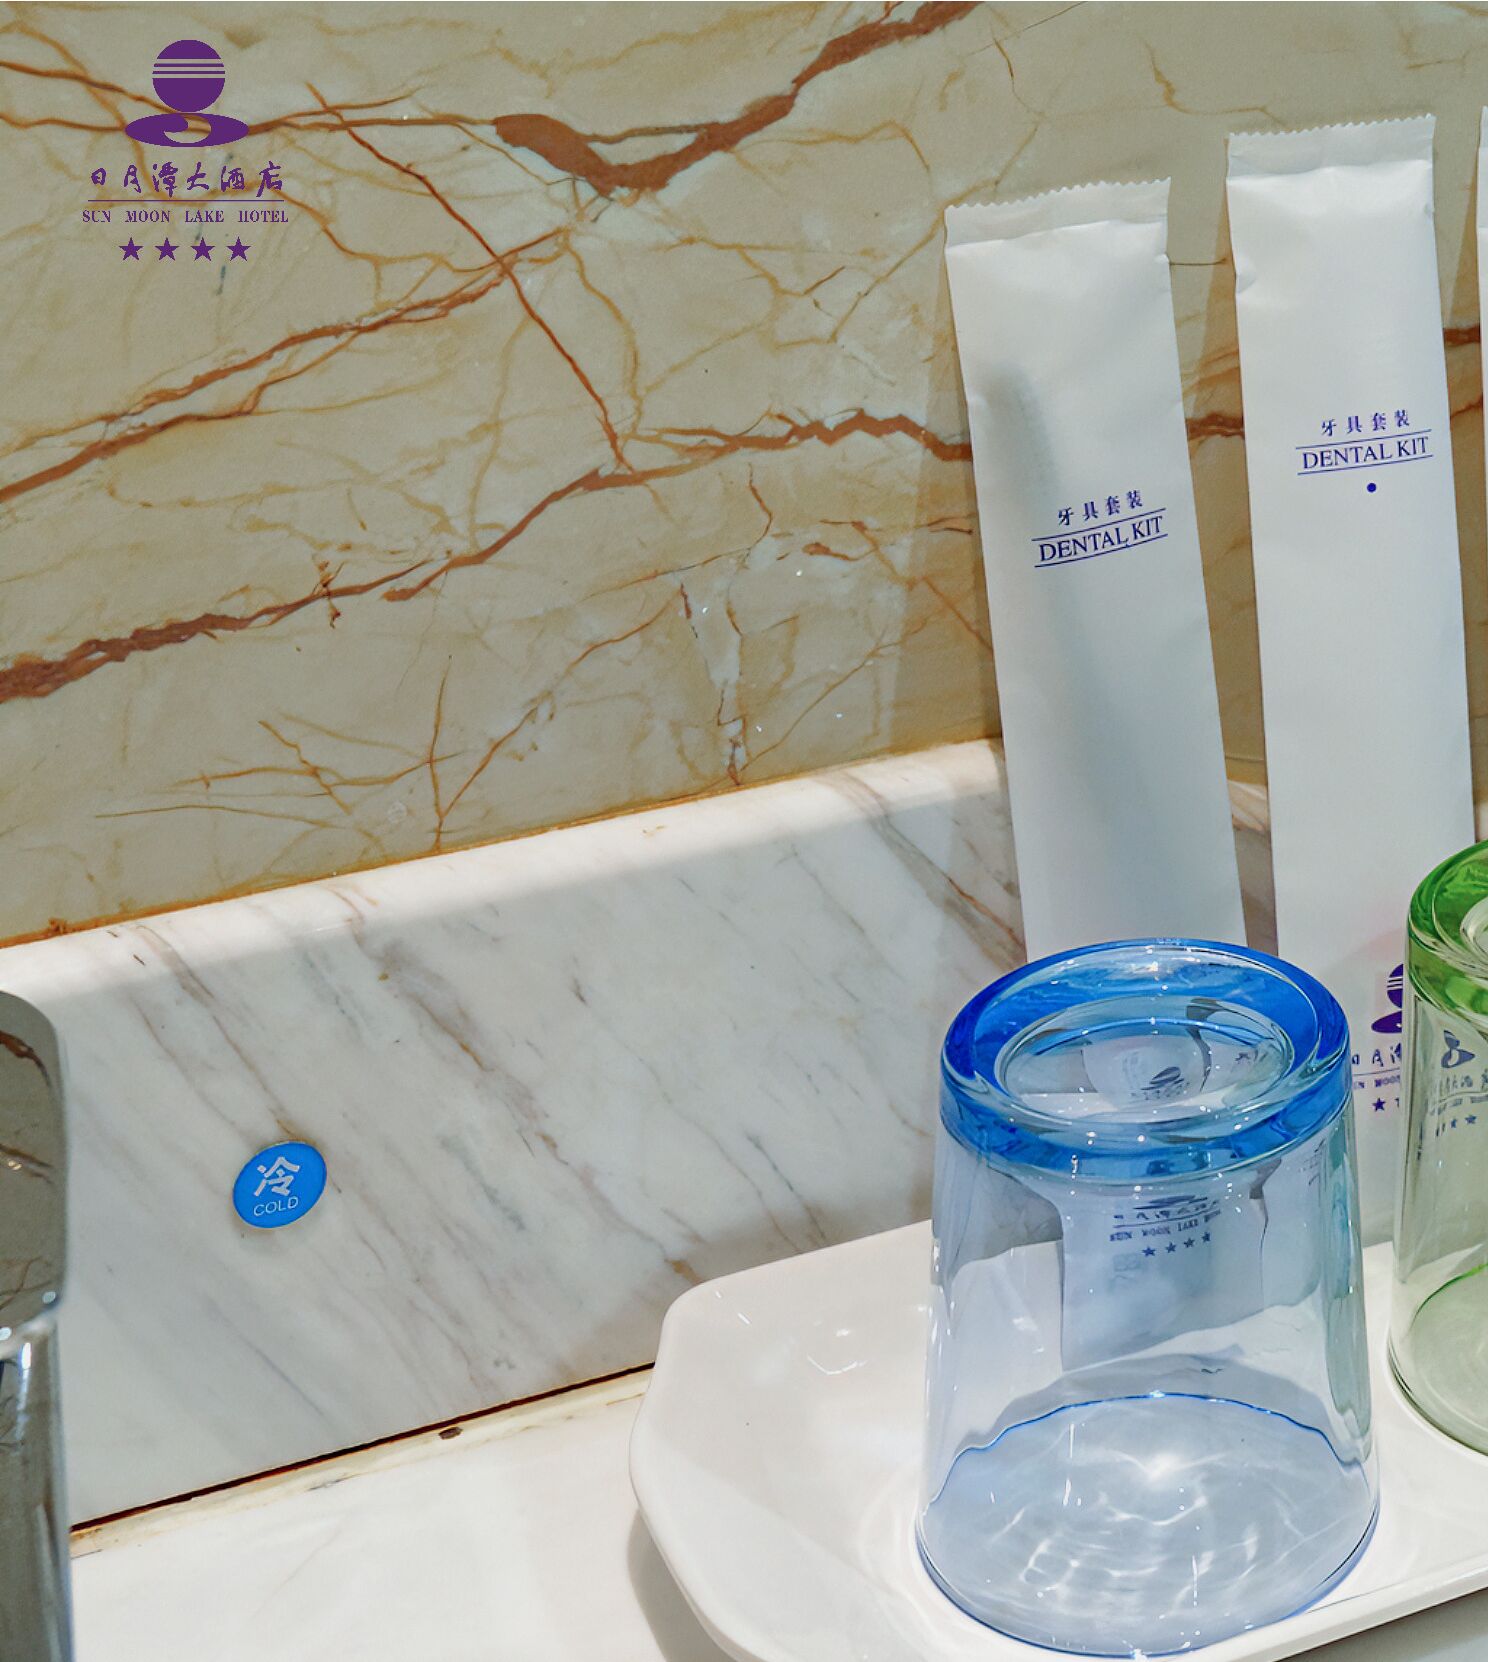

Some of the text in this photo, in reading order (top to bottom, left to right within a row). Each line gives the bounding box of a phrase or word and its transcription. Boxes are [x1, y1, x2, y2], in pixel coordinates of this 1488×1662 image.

[1321, 409, 1410, 437] 牙具套装
[1302, 436, 1429, 469] DENTAL KIT
[1058, 489, 1143, 526] 牙具套装
[1039, 515, 1163, 562] DENTAL KIT
[254, 1156, 300, 1197] 冷
[253, 1196, 299, 1217] COLD
